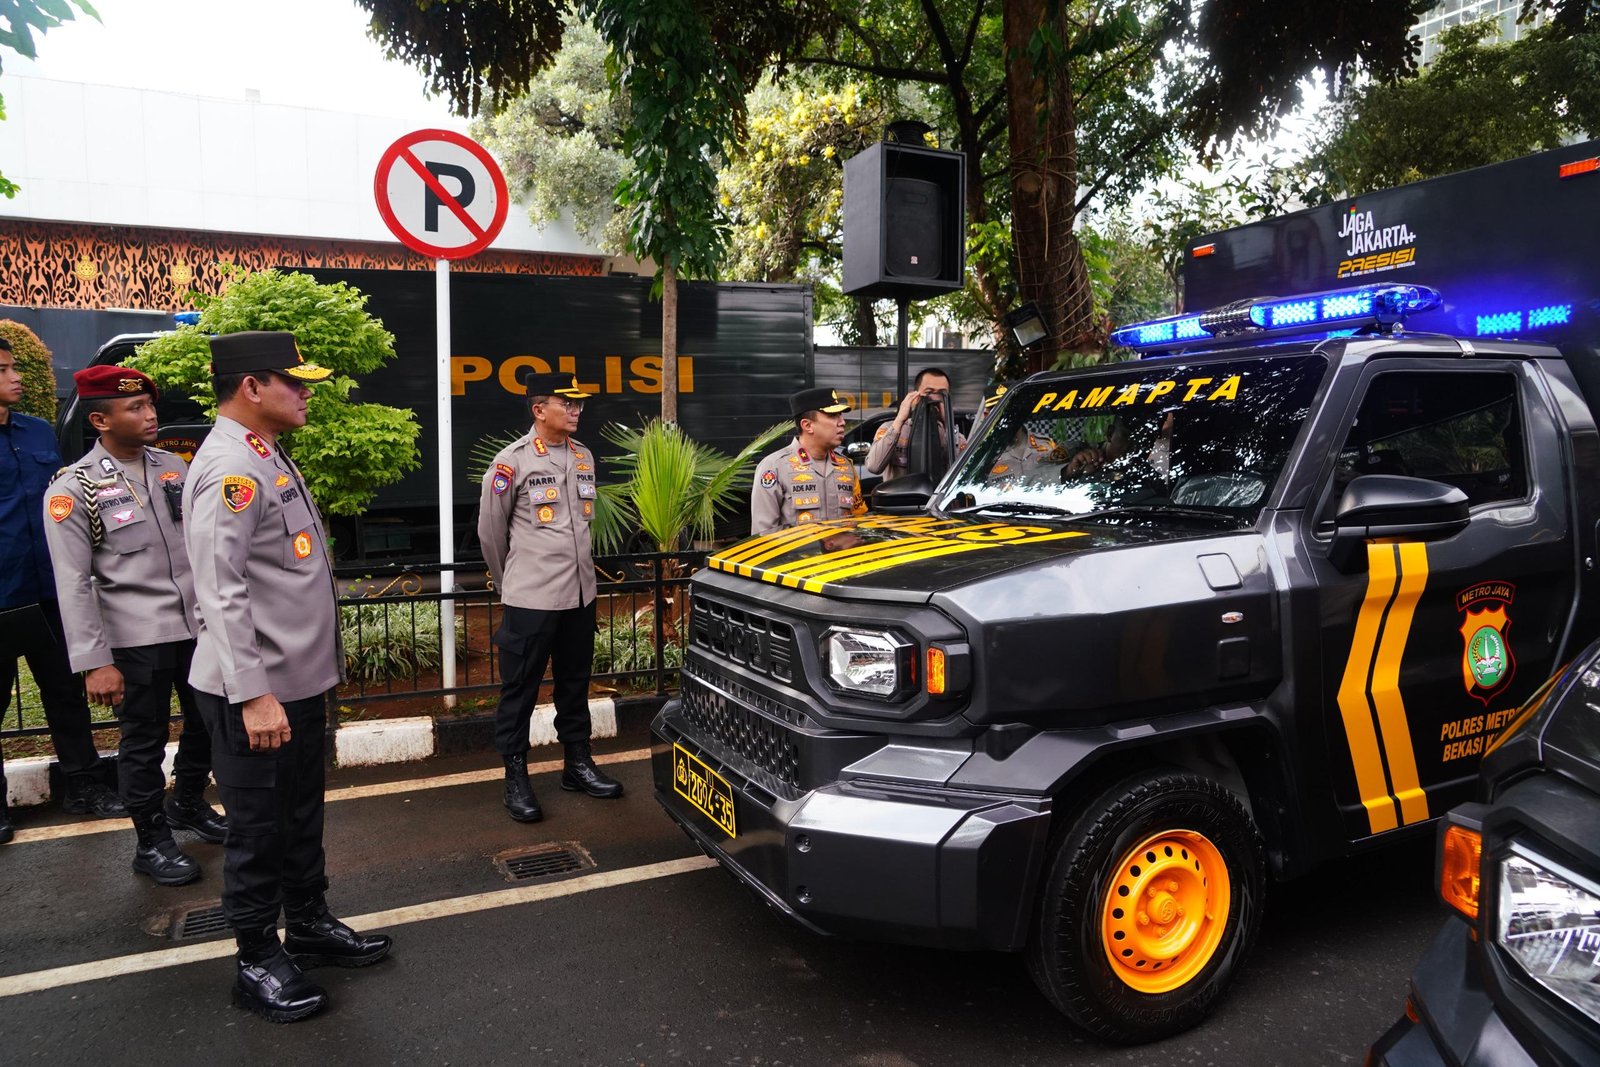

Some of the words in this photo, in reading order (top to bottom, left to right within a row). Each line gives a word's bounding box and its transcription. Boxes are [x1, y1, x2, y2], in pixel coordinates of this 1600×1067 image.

[425, 161, 475, 232] P
[1338, 206, 1374, 238] JAGA
[1338, 248, 1415, 275] PRESISI
[450, 355, 694, 395] POLISI
[1032, 375, 1241, 414] PAMAPTA
[180, 440, 197, 448] JAYA
[529, 476, 556, 487] HARRI
[793, 484, 804, 493] ADE
[805, 484, 817, 492] ARY
[98, 498, 119, 511] SATRIO
[1462, 586, 1491, 604] METRO
[1492, 585, 1510, 598] JAYA
[1440, 714, 1484, 741] POLRES
[1442, 736, 1483, 762] BEKASI
